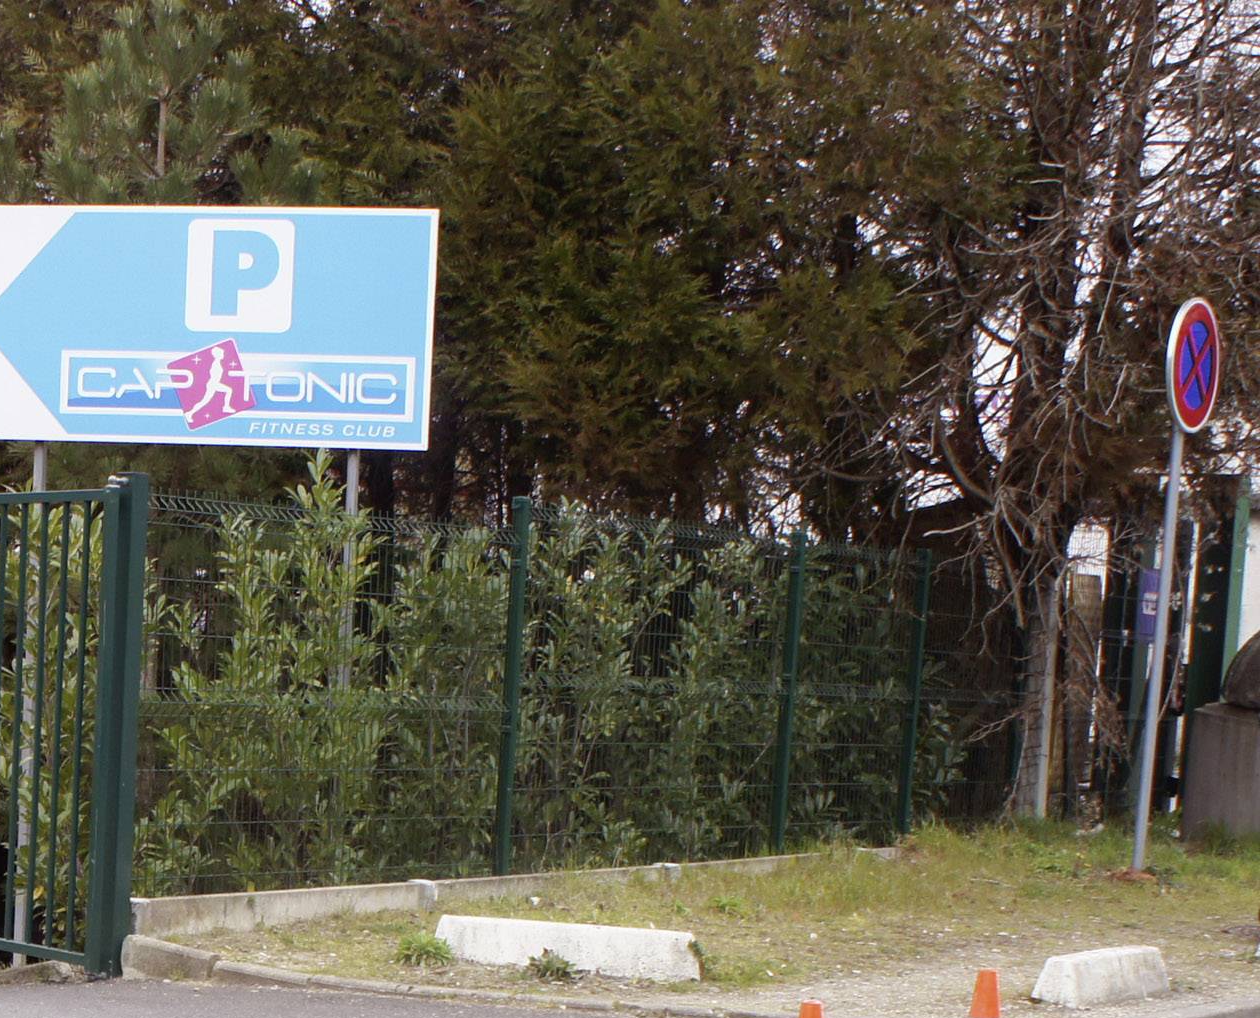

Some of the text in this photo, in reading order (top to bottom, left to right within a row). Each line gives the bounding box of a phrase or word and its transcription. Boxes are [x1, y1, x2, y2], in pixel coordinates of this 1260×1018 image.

[210, 229, 280, 317] P
[77, 367, 398, 405] CAP TONIC
[249, 422, 396, 438] FITNESS CLUB
